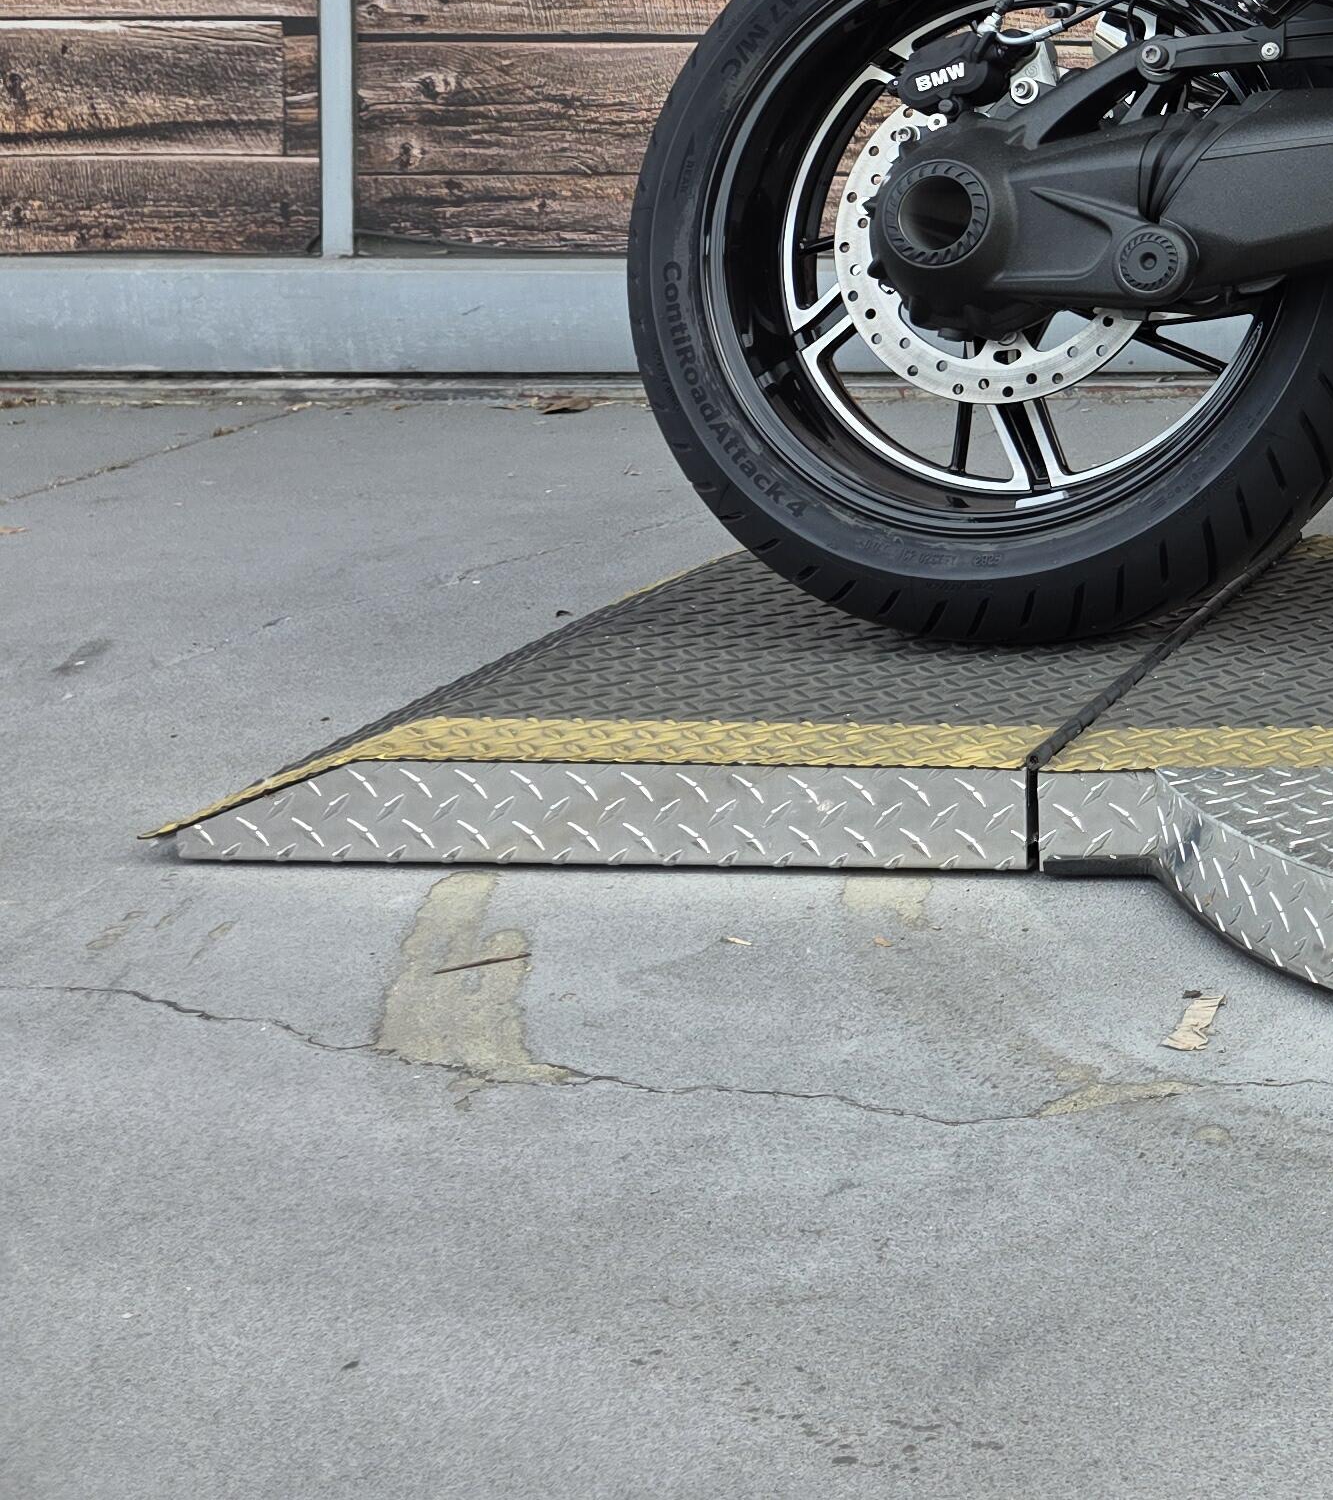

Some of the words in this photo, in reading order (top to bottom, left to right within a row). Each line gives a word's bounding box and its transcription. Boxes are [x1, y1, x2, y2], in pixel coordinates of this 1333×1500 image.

[914, 61, 965, 92] BMW
[661, 259, 790, 506] ContiRoadAttack
[781, 494, 809, 522] 4
